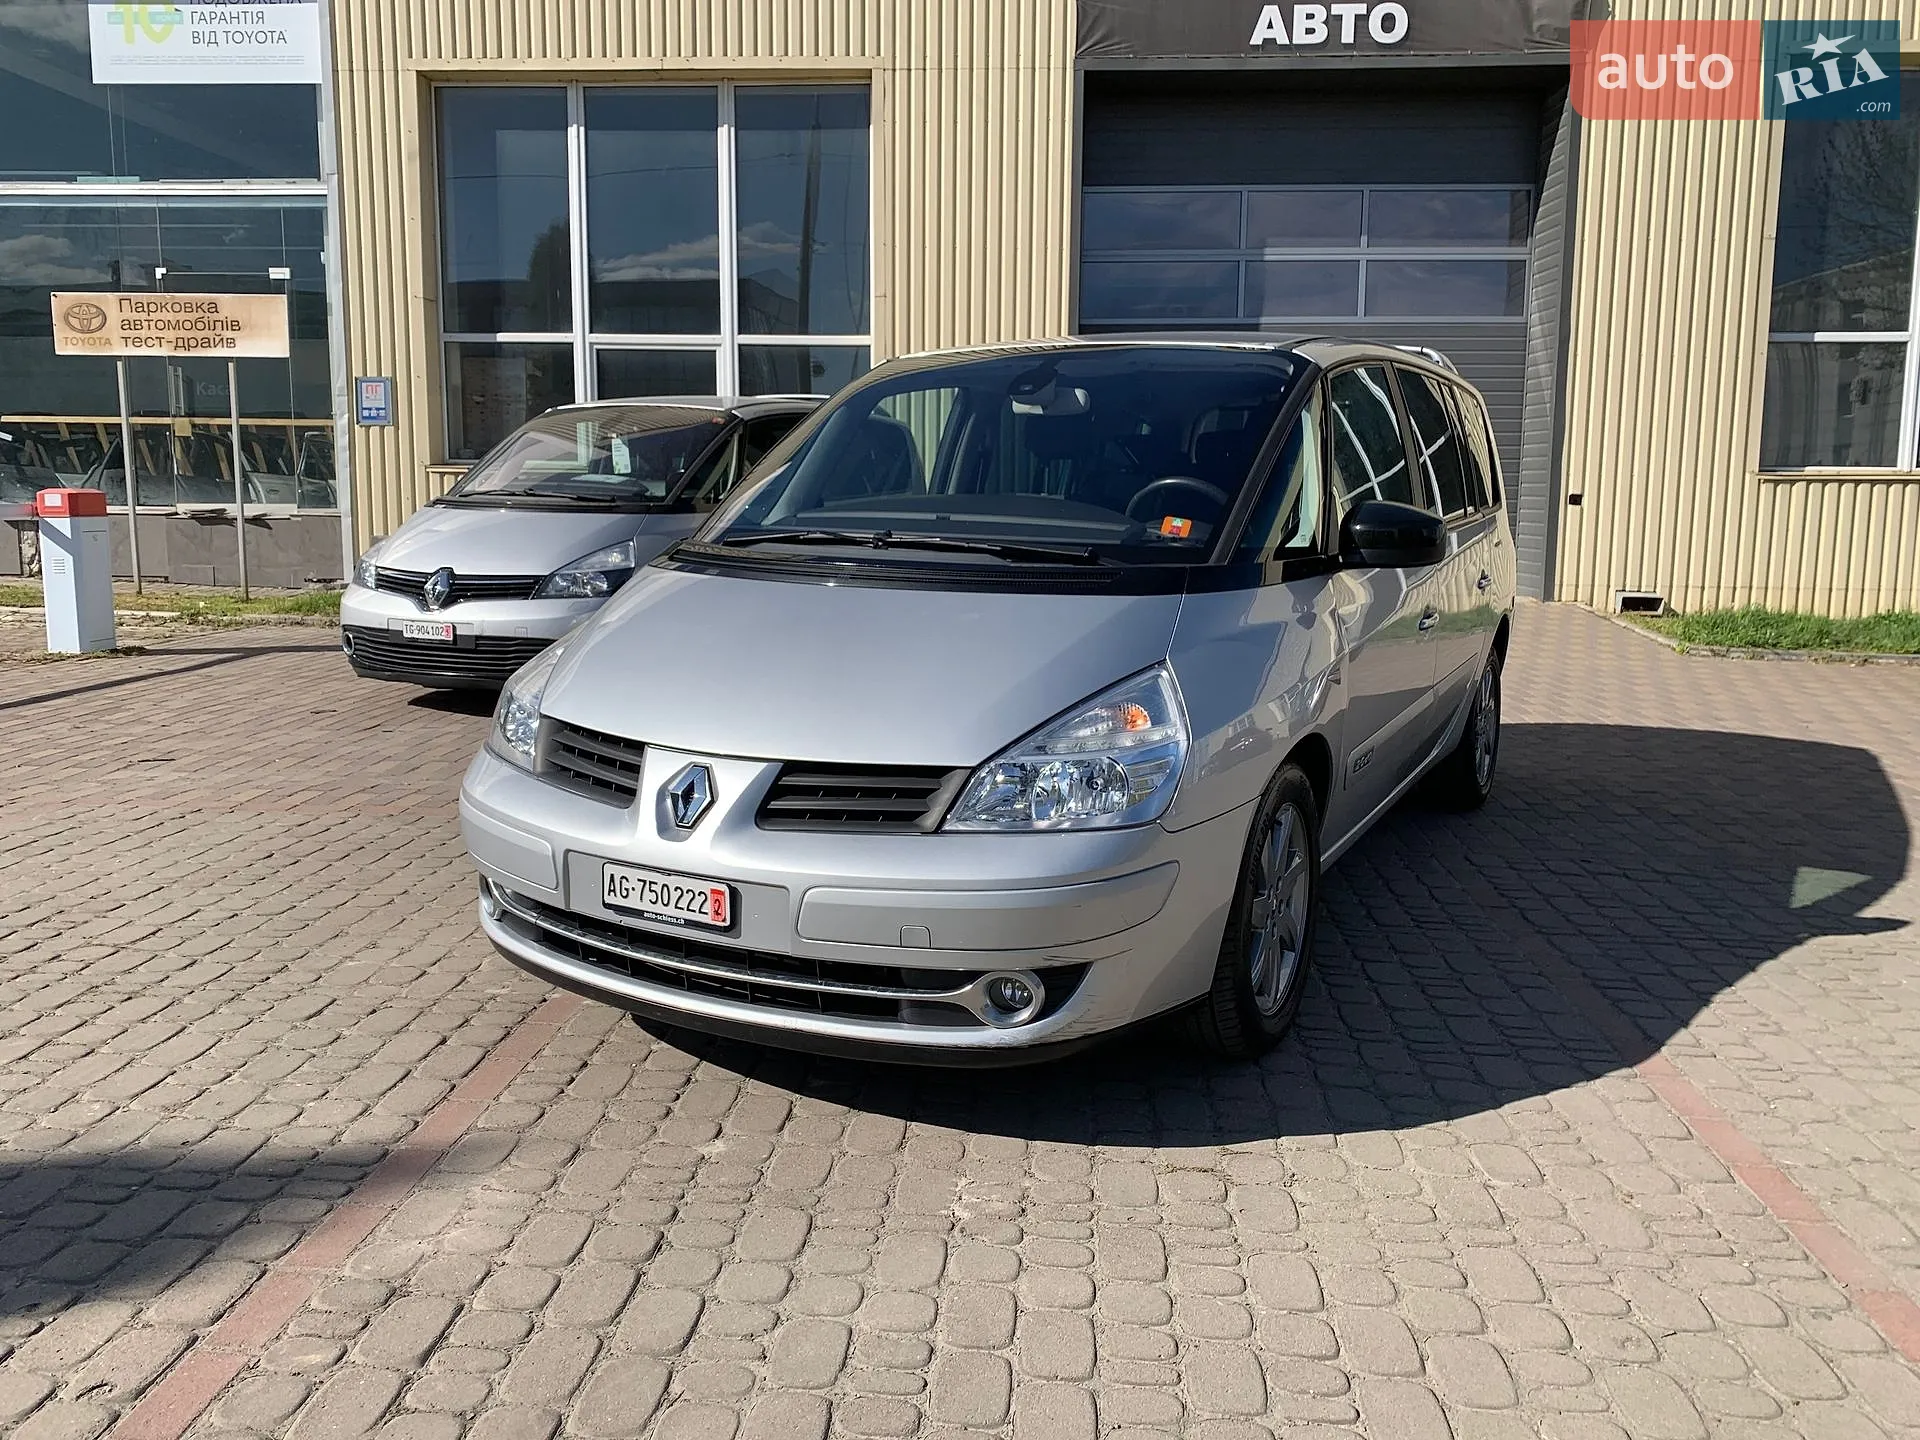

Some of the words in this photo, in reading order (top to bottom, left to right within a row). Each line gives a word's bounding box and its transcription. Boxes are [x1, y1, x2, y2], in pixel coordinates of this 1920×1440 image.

[190, 11, 265, 25] ГАРАНТІЯ
[1249, 2, 1408, 45] АВТО
[192, 31, 219, 47] ВІД
[223, 30, 287, 44] TOYOTA
[118, 298, 220, 315] Парковка
[120, 317, 241, 332] автомобілів
[62, 336, 113, 347] TOYOTA
[121, 333, 236, 351] тест-драйв
